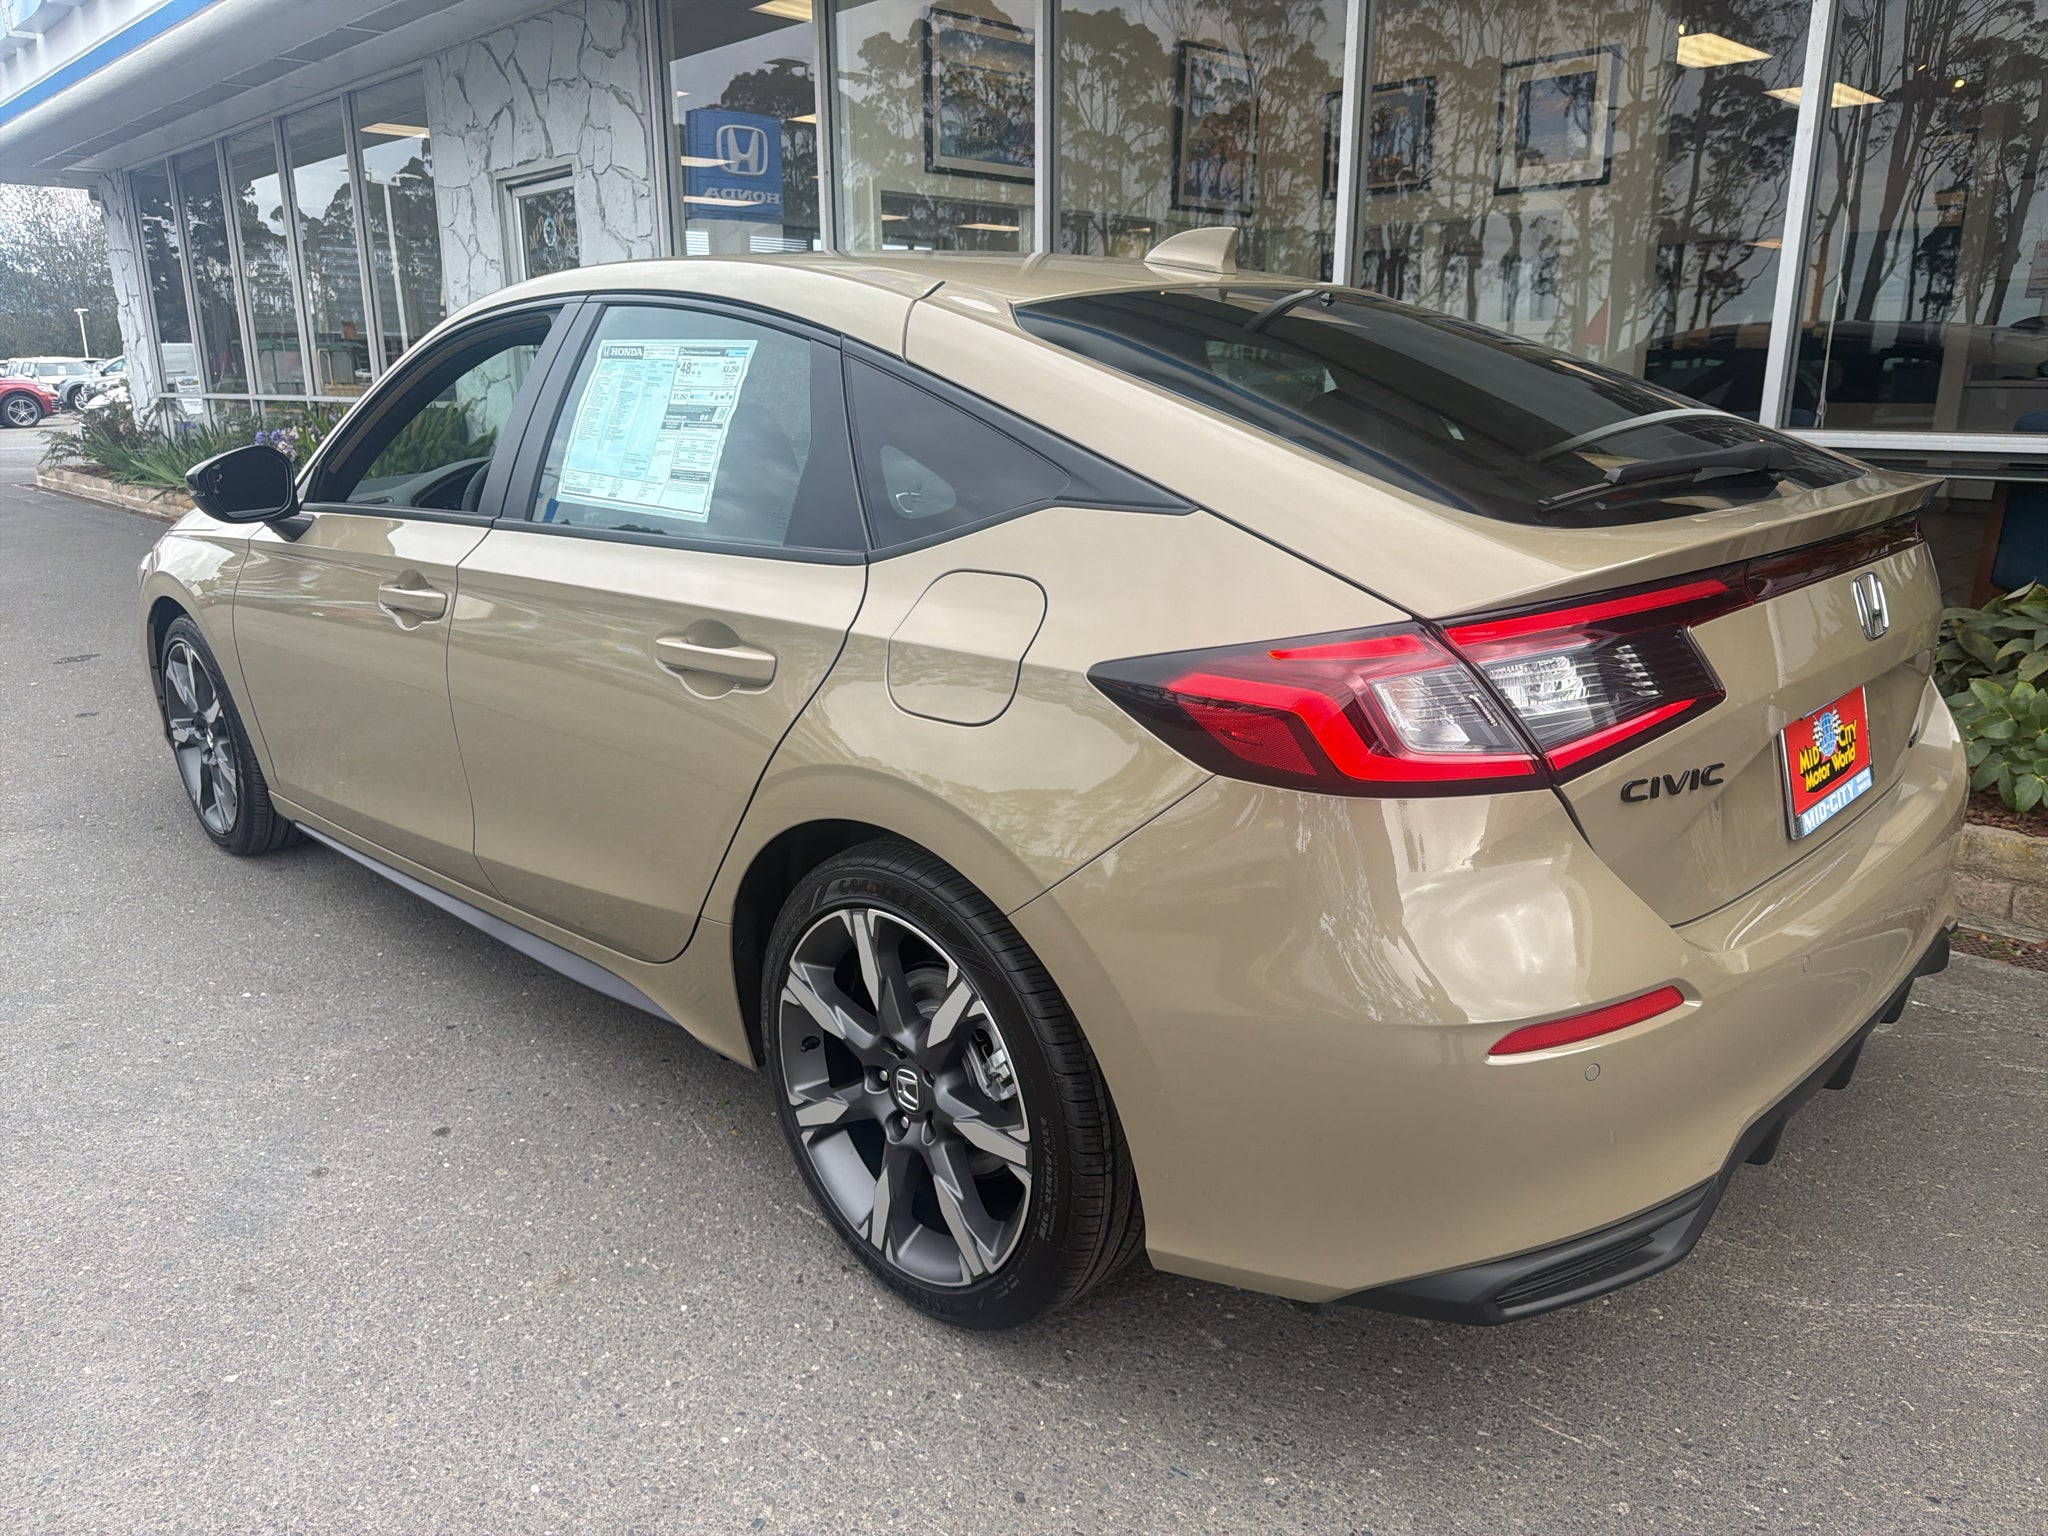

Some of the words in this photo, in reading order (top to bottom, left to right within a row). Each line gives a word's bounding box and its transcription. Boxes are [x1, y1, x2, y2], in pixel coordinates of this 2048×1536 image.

[610, 347, 643, 357] HONDA
[680, 362, 692, 375] 48
[1798, 745, 1820, 775] MID
[1837, 719, 1857, 747] CITY
[1805, 762, 1831, 792] Motor
[1830, 742, 1856, 772] World
[1620, 762, 1725, 803] CIVIC
